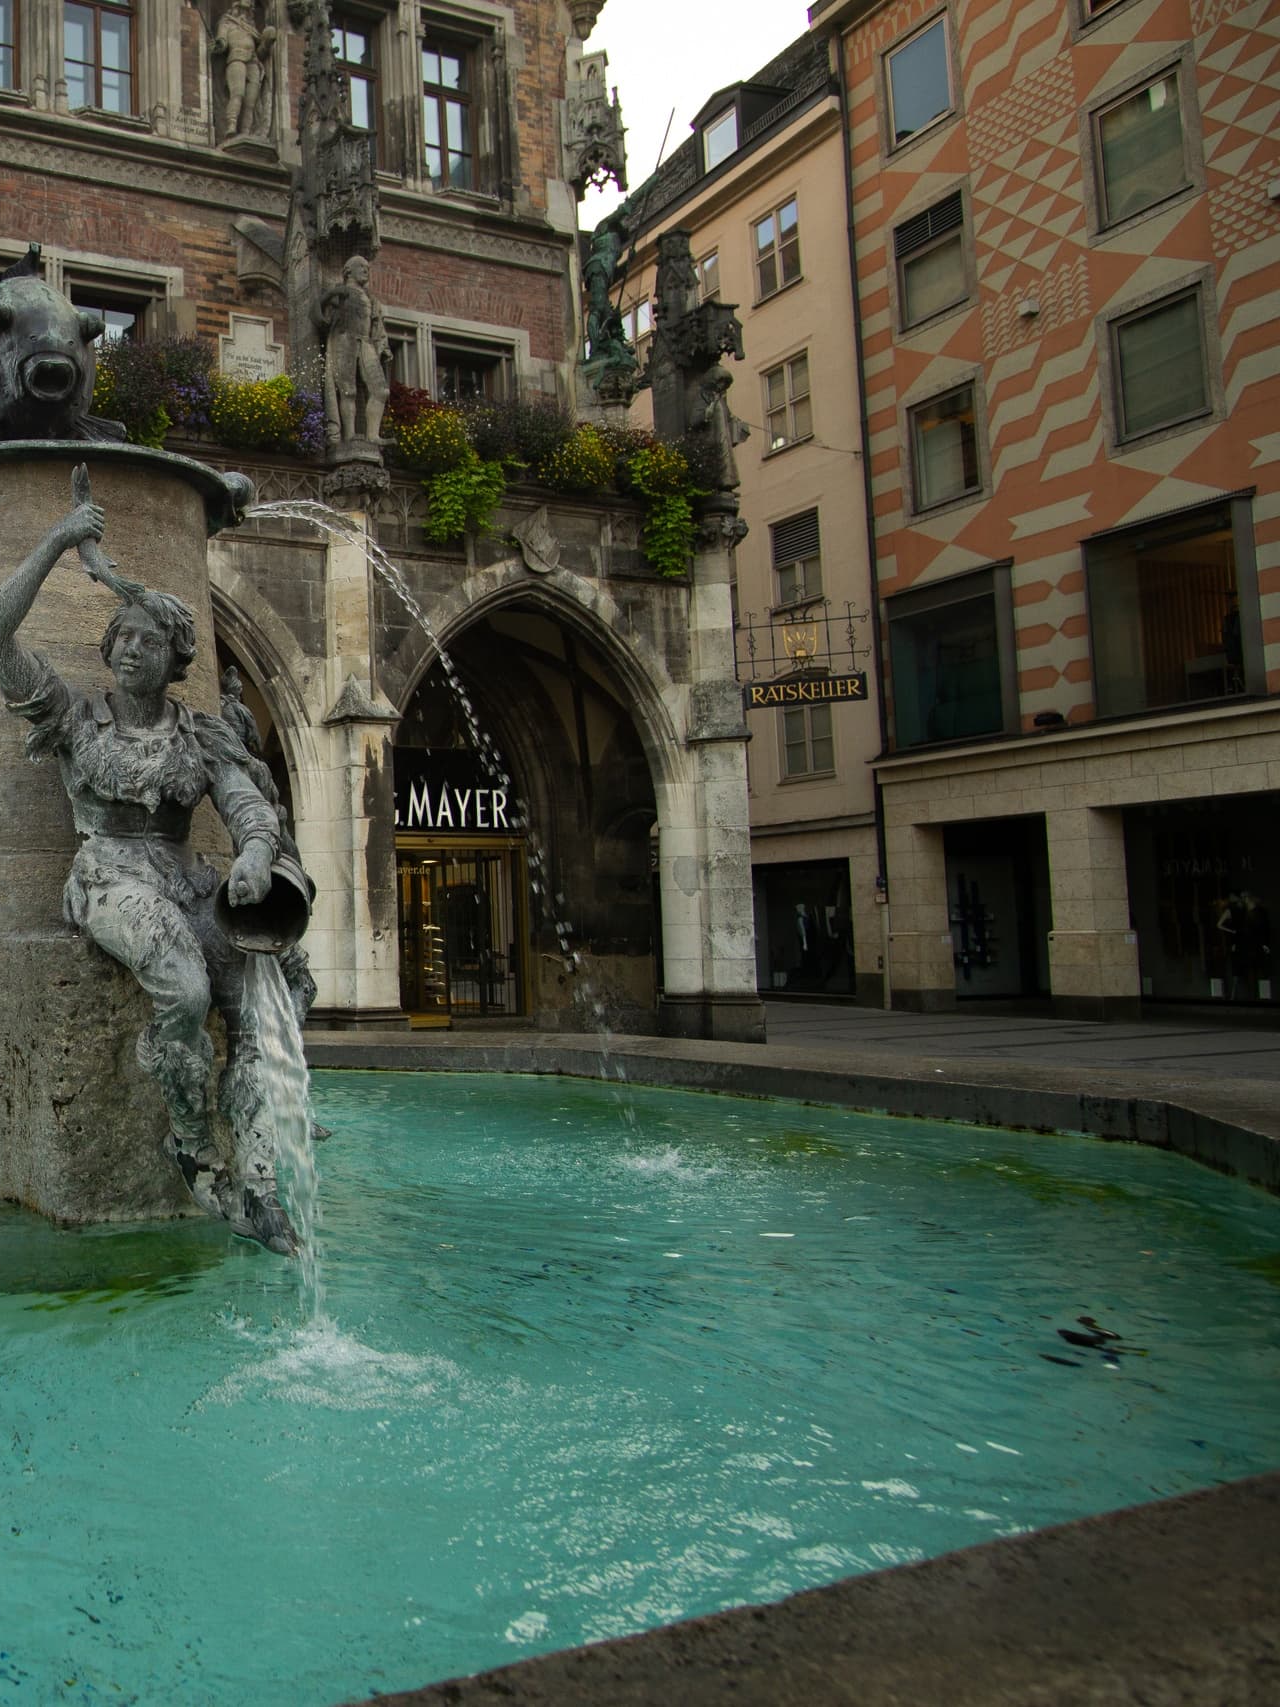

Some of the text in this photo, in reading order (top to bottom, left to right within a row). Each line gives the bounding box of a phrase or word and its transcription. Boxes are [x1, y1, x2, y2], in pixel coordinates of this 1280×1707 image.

[750, 678, 862, 704] RATSKELLER
[407, 780, 509, 828] MAYER
[397, 864, 431, 875] ayer.de
